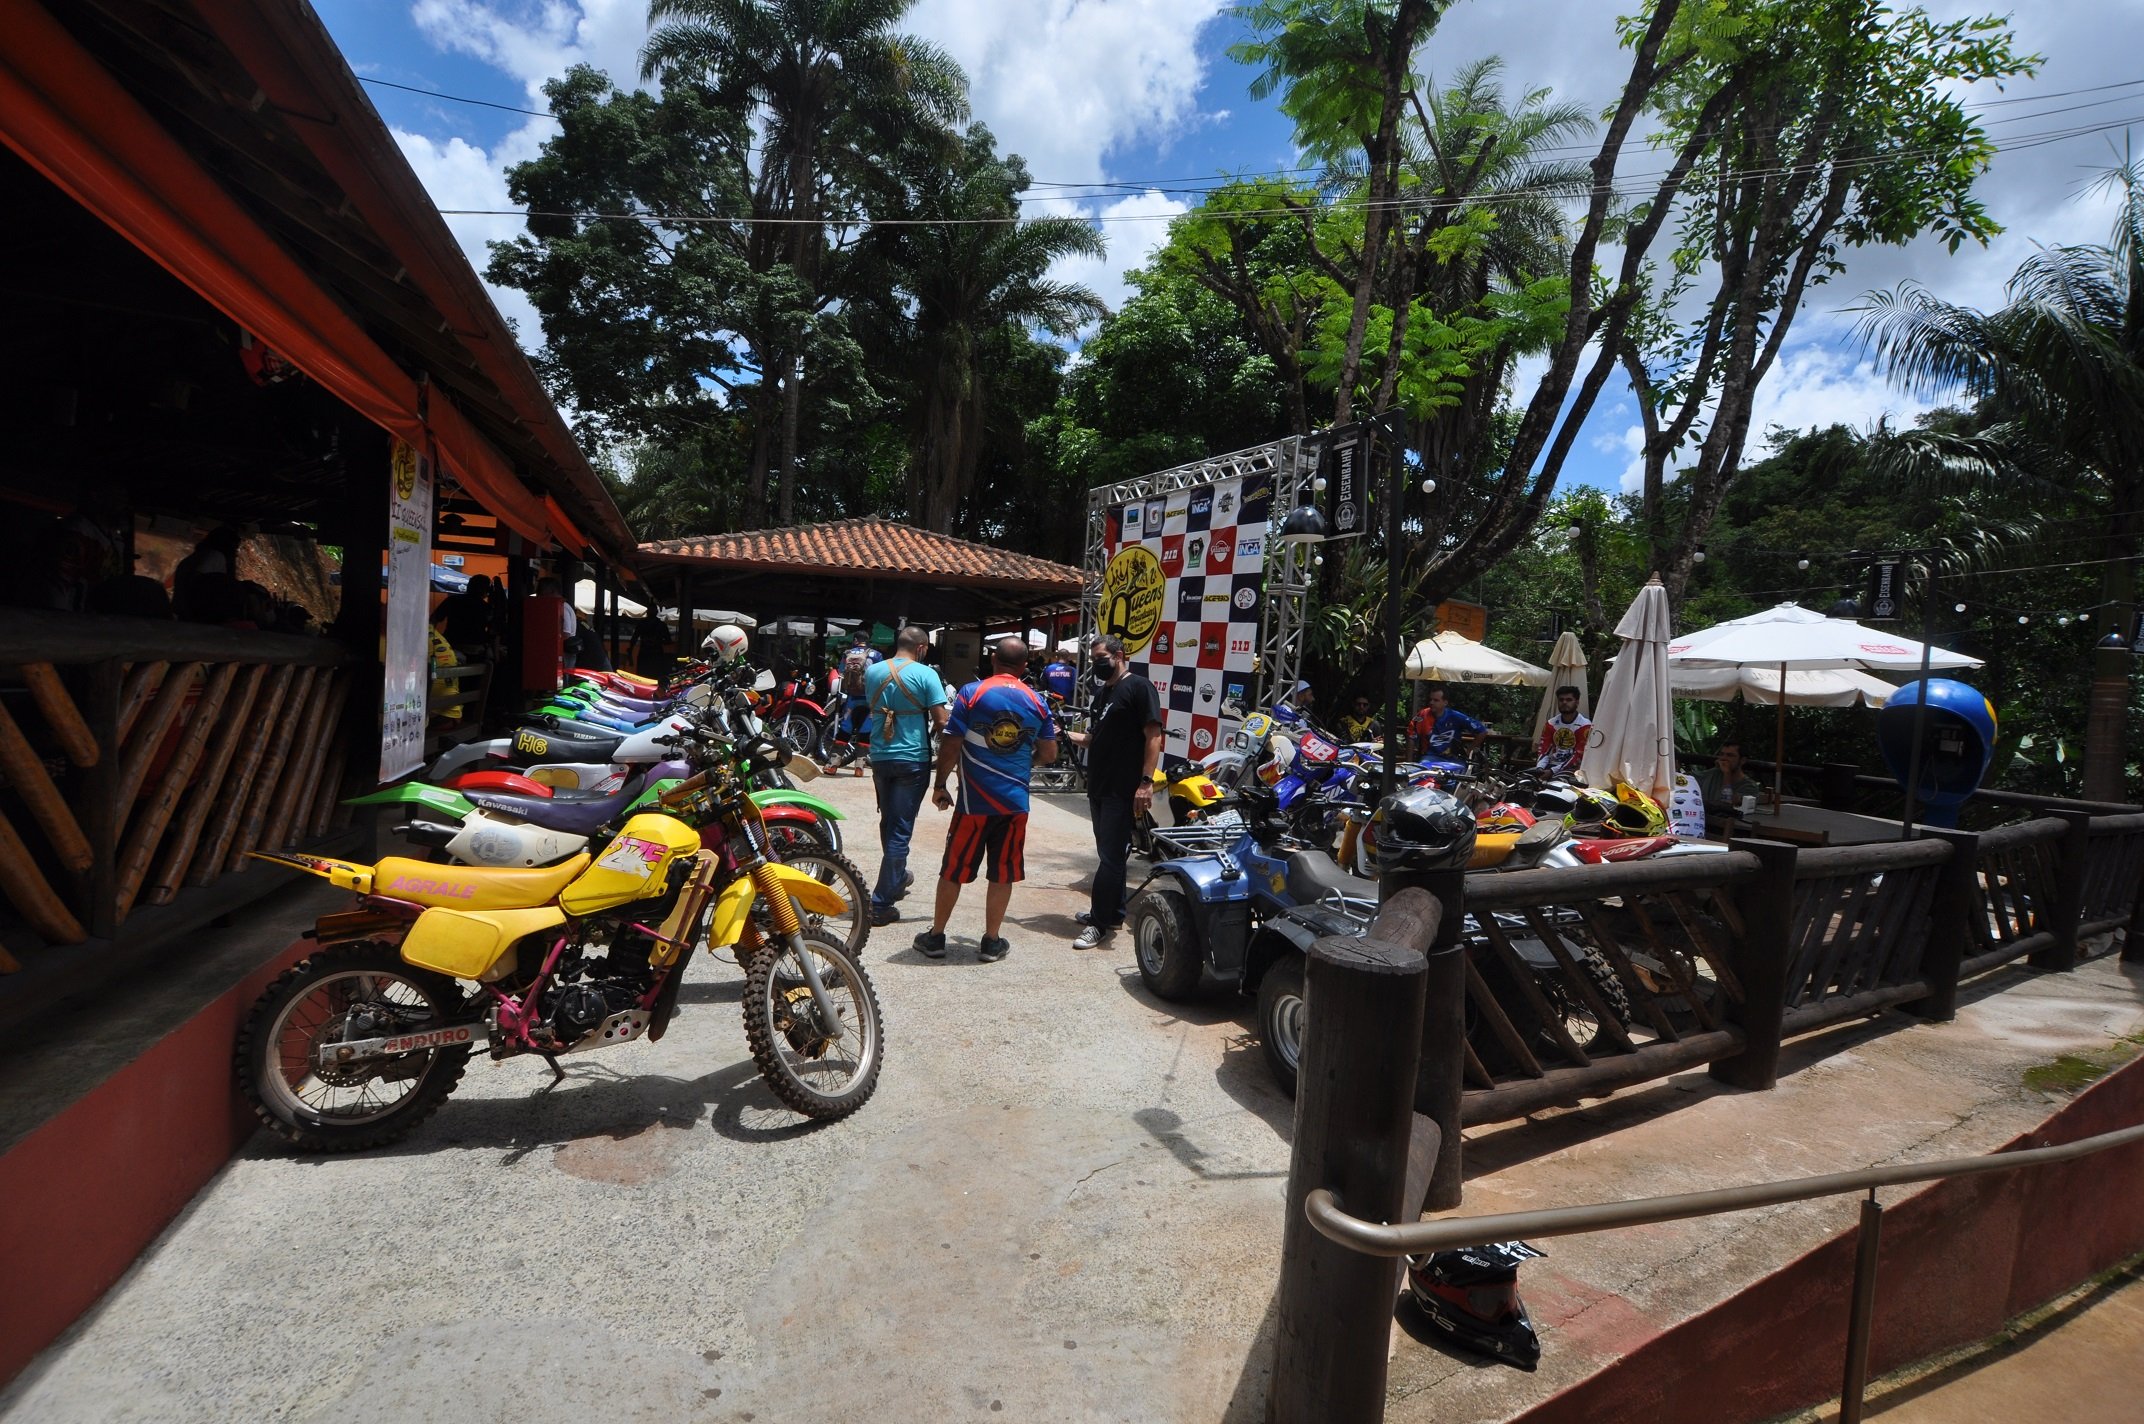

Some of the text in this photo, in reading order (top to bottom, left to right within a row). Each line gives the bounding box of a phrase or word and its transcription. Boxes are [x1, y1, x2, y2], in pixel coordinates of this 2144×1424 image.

[1340, 448, 1353, 502] EISENBAHN
[1238, 543, 1260, 555] INGA
[1879, 565, 1893, 598] EISENBAHN
[517, 732, 548, 755] H6
[1301, 738, 1335, 761] 98
[477, 798, 528, 816] Kawasaki
[388, 875, 479, 900] AGRALE
[386, 1027, 470, 1052] ENDURO
